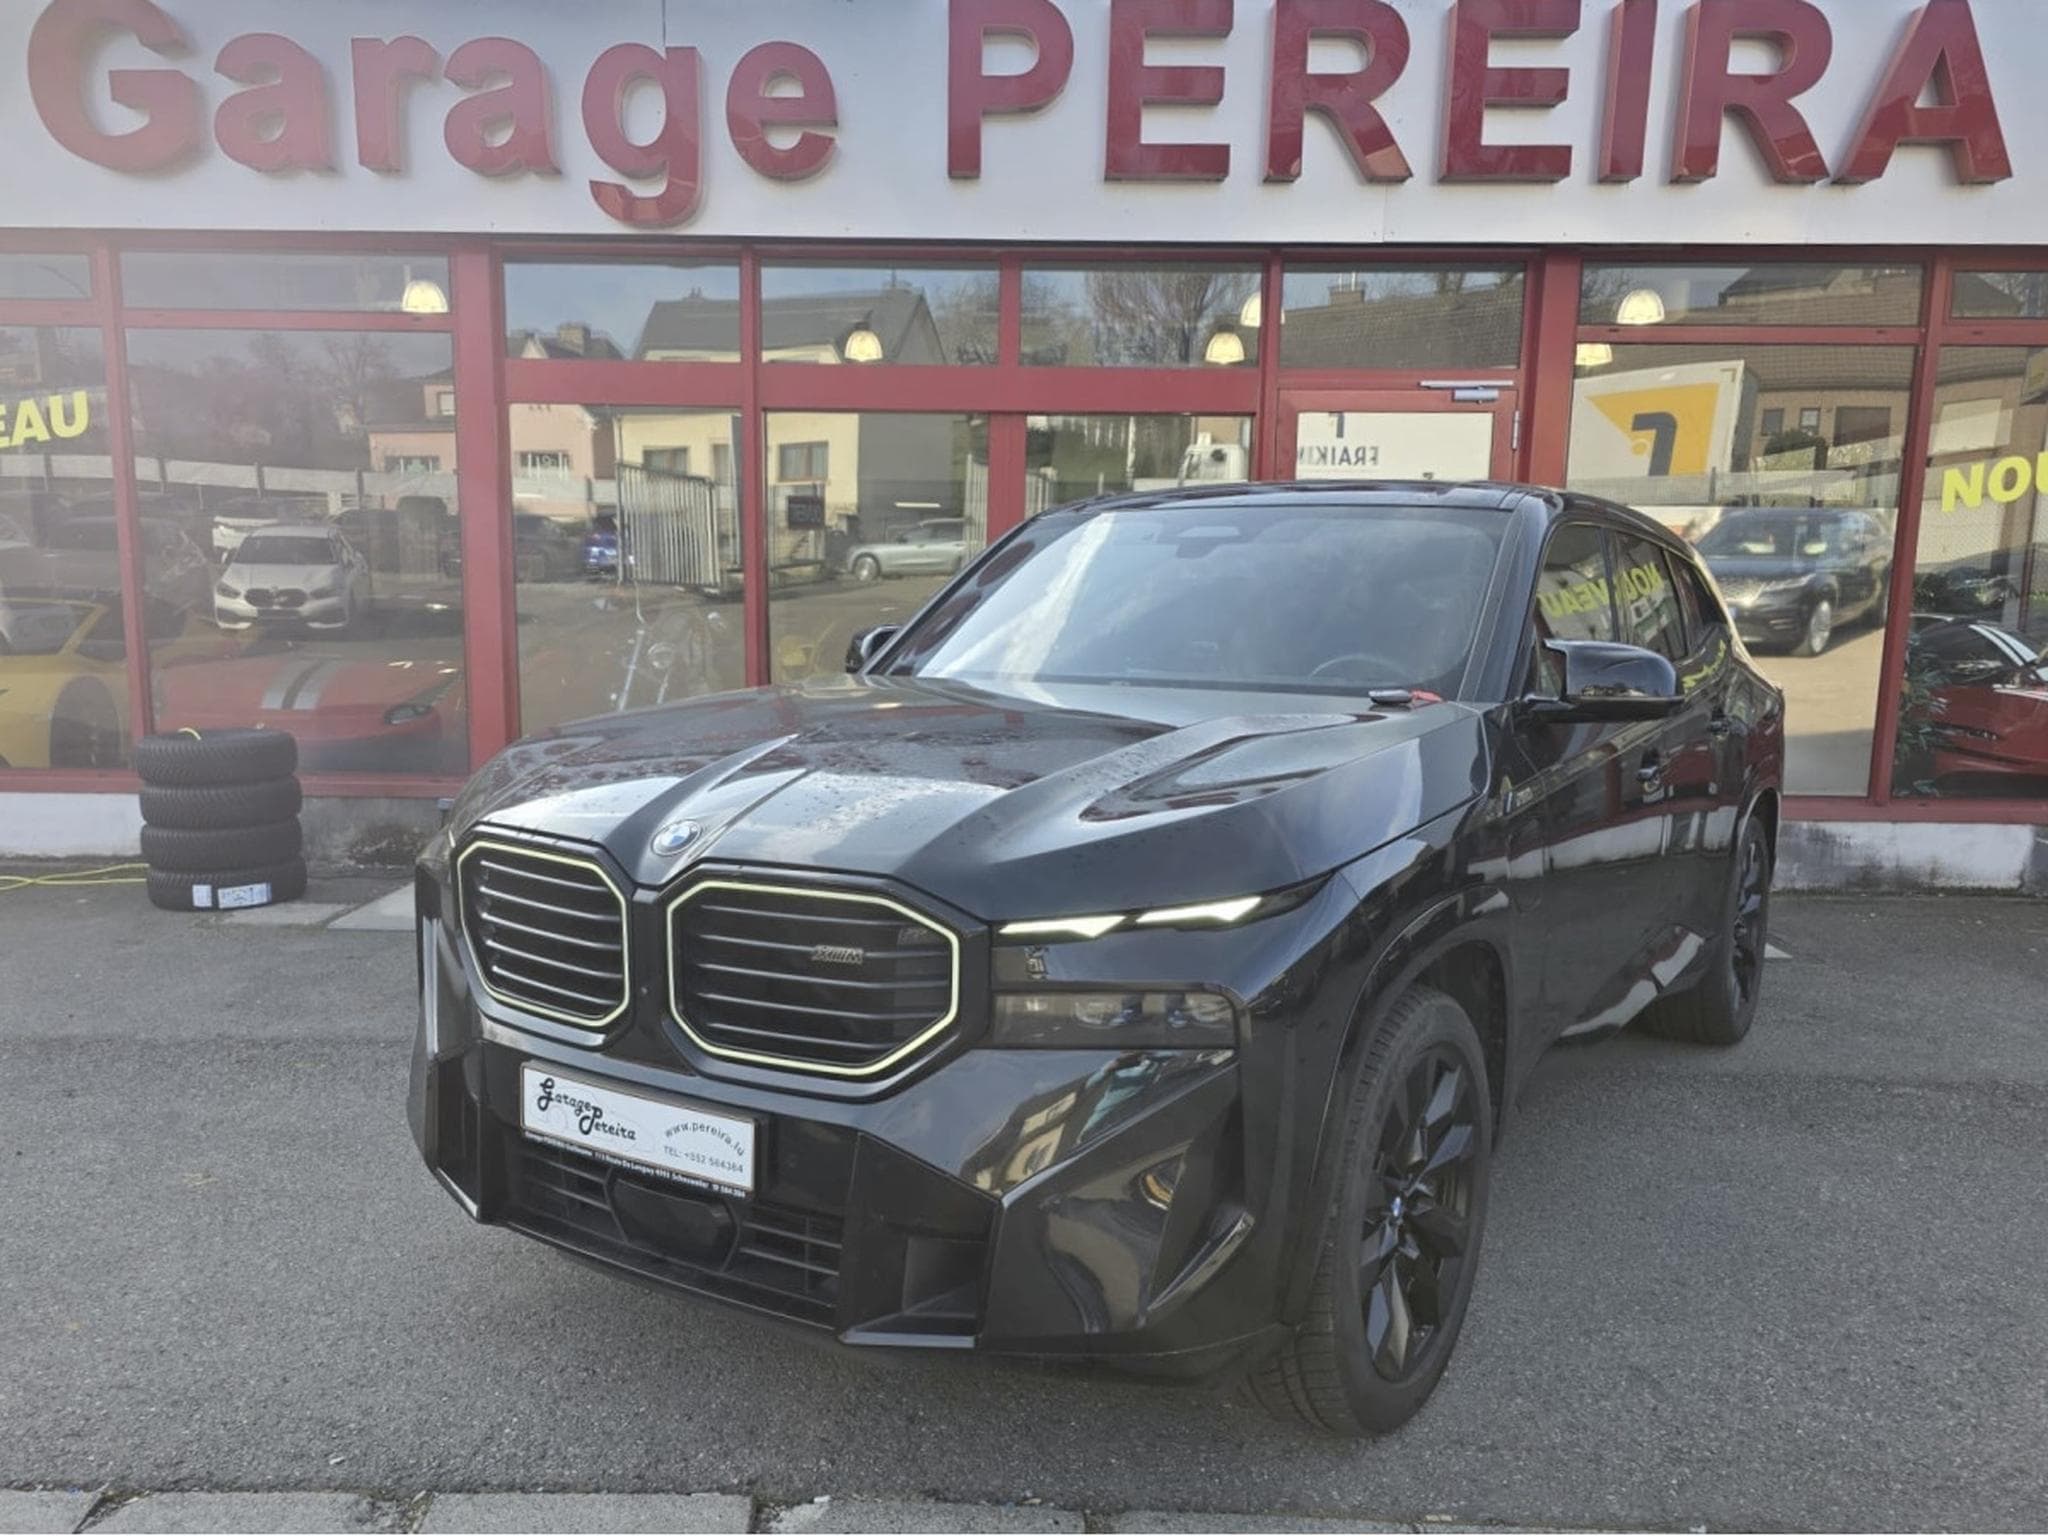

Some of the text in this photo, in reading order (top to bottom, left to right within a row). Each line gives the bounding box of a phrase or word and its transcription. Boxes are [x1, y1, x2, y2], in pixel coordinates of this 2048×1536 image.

[26, 0, 2013, 229] Garage PEREIRA
[537, 1077, 592, 1117] Garage
[578, 1105, 637, 1140] Pereira
[665, 1122, 745, 1157] www.pereira.lu
